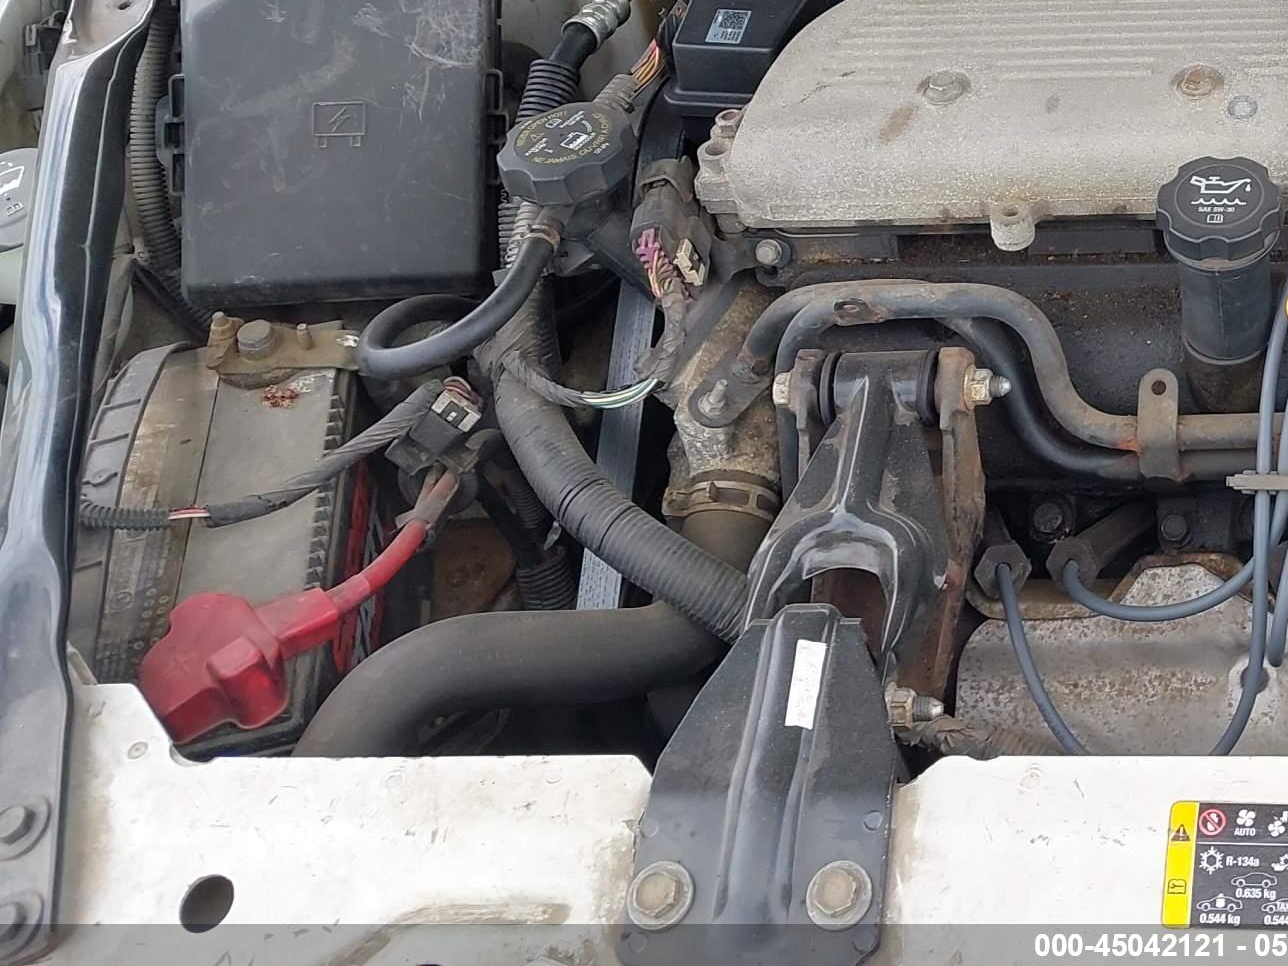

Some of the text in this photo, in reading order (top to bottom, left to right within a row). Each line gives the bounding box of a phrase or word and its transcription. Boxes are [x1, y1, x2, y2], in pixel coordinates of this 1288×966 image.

[1234, 827, 1256, 836] AUTO
[1226, 856, 1260, 867] R-134a
[1235, 888, 1277, 901] 0.635 kg
[1199, 913, 1241, 926] 0.544 kg
